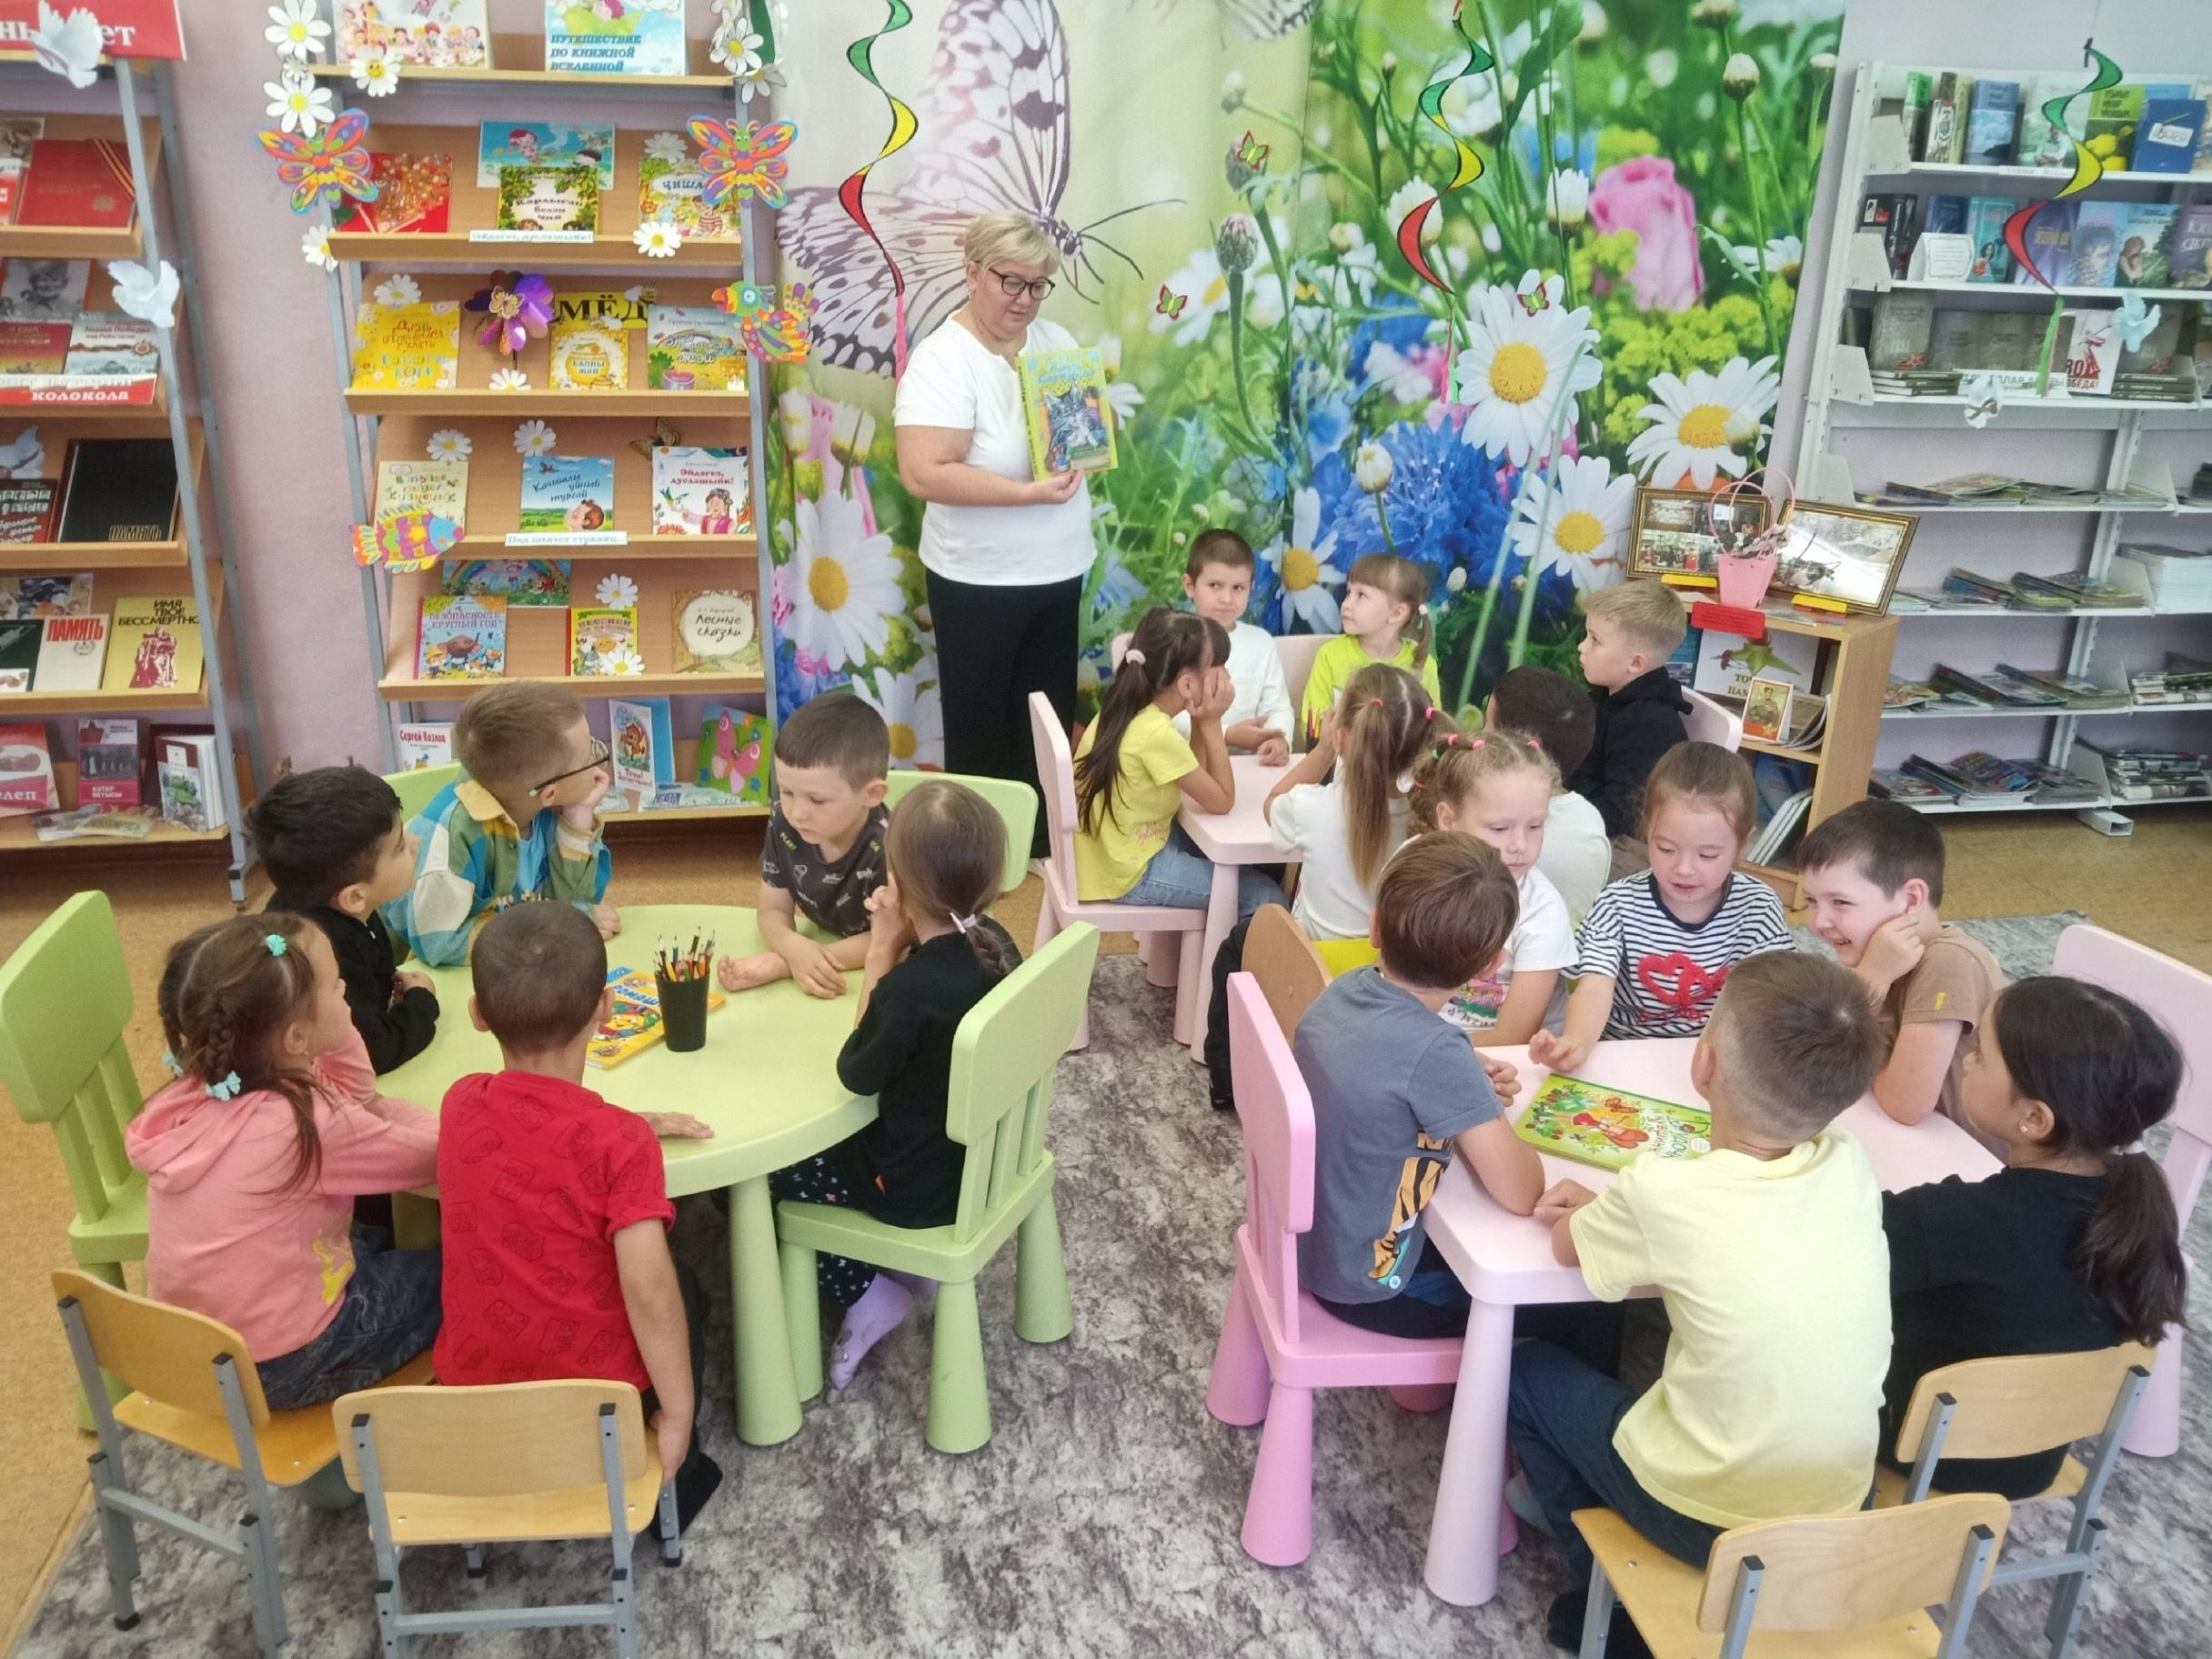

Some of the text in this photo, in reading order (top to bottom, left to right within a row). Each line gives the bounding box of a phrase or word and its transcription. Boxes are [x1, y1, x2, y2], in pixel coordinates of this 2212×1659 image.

[101, 26, 136, 45] ет
[551, 34, 641, 45] ПУТЕШЕСТВИЕ
[551, 45, 635, 58] ПО КНИЖНОЙ
[551, 60, 624, 73] ВСЕЛЕННОЙ
[553, 294, 649, 323] МЁД
[2066, 379, 2099, 389] ОБЕДА!
[154, 599, 182, 608] ИМЯ
[154, 608, 185, 617] ТВОЕ
[429, 610, 499, 619] БЕЗОПАСНОСТЬ
[432, 619, 497, 628] КРУГЛЫЙ ГОД
[696, 614, 741, 625] Лесные
[46, 618, 104, 641] ПАМЯТЬ
[697, 625, 741, 643] сказки
[400, 729, 446, 742] Сергей Козлов
[613, 985, 659, 1005] РОМАШ
